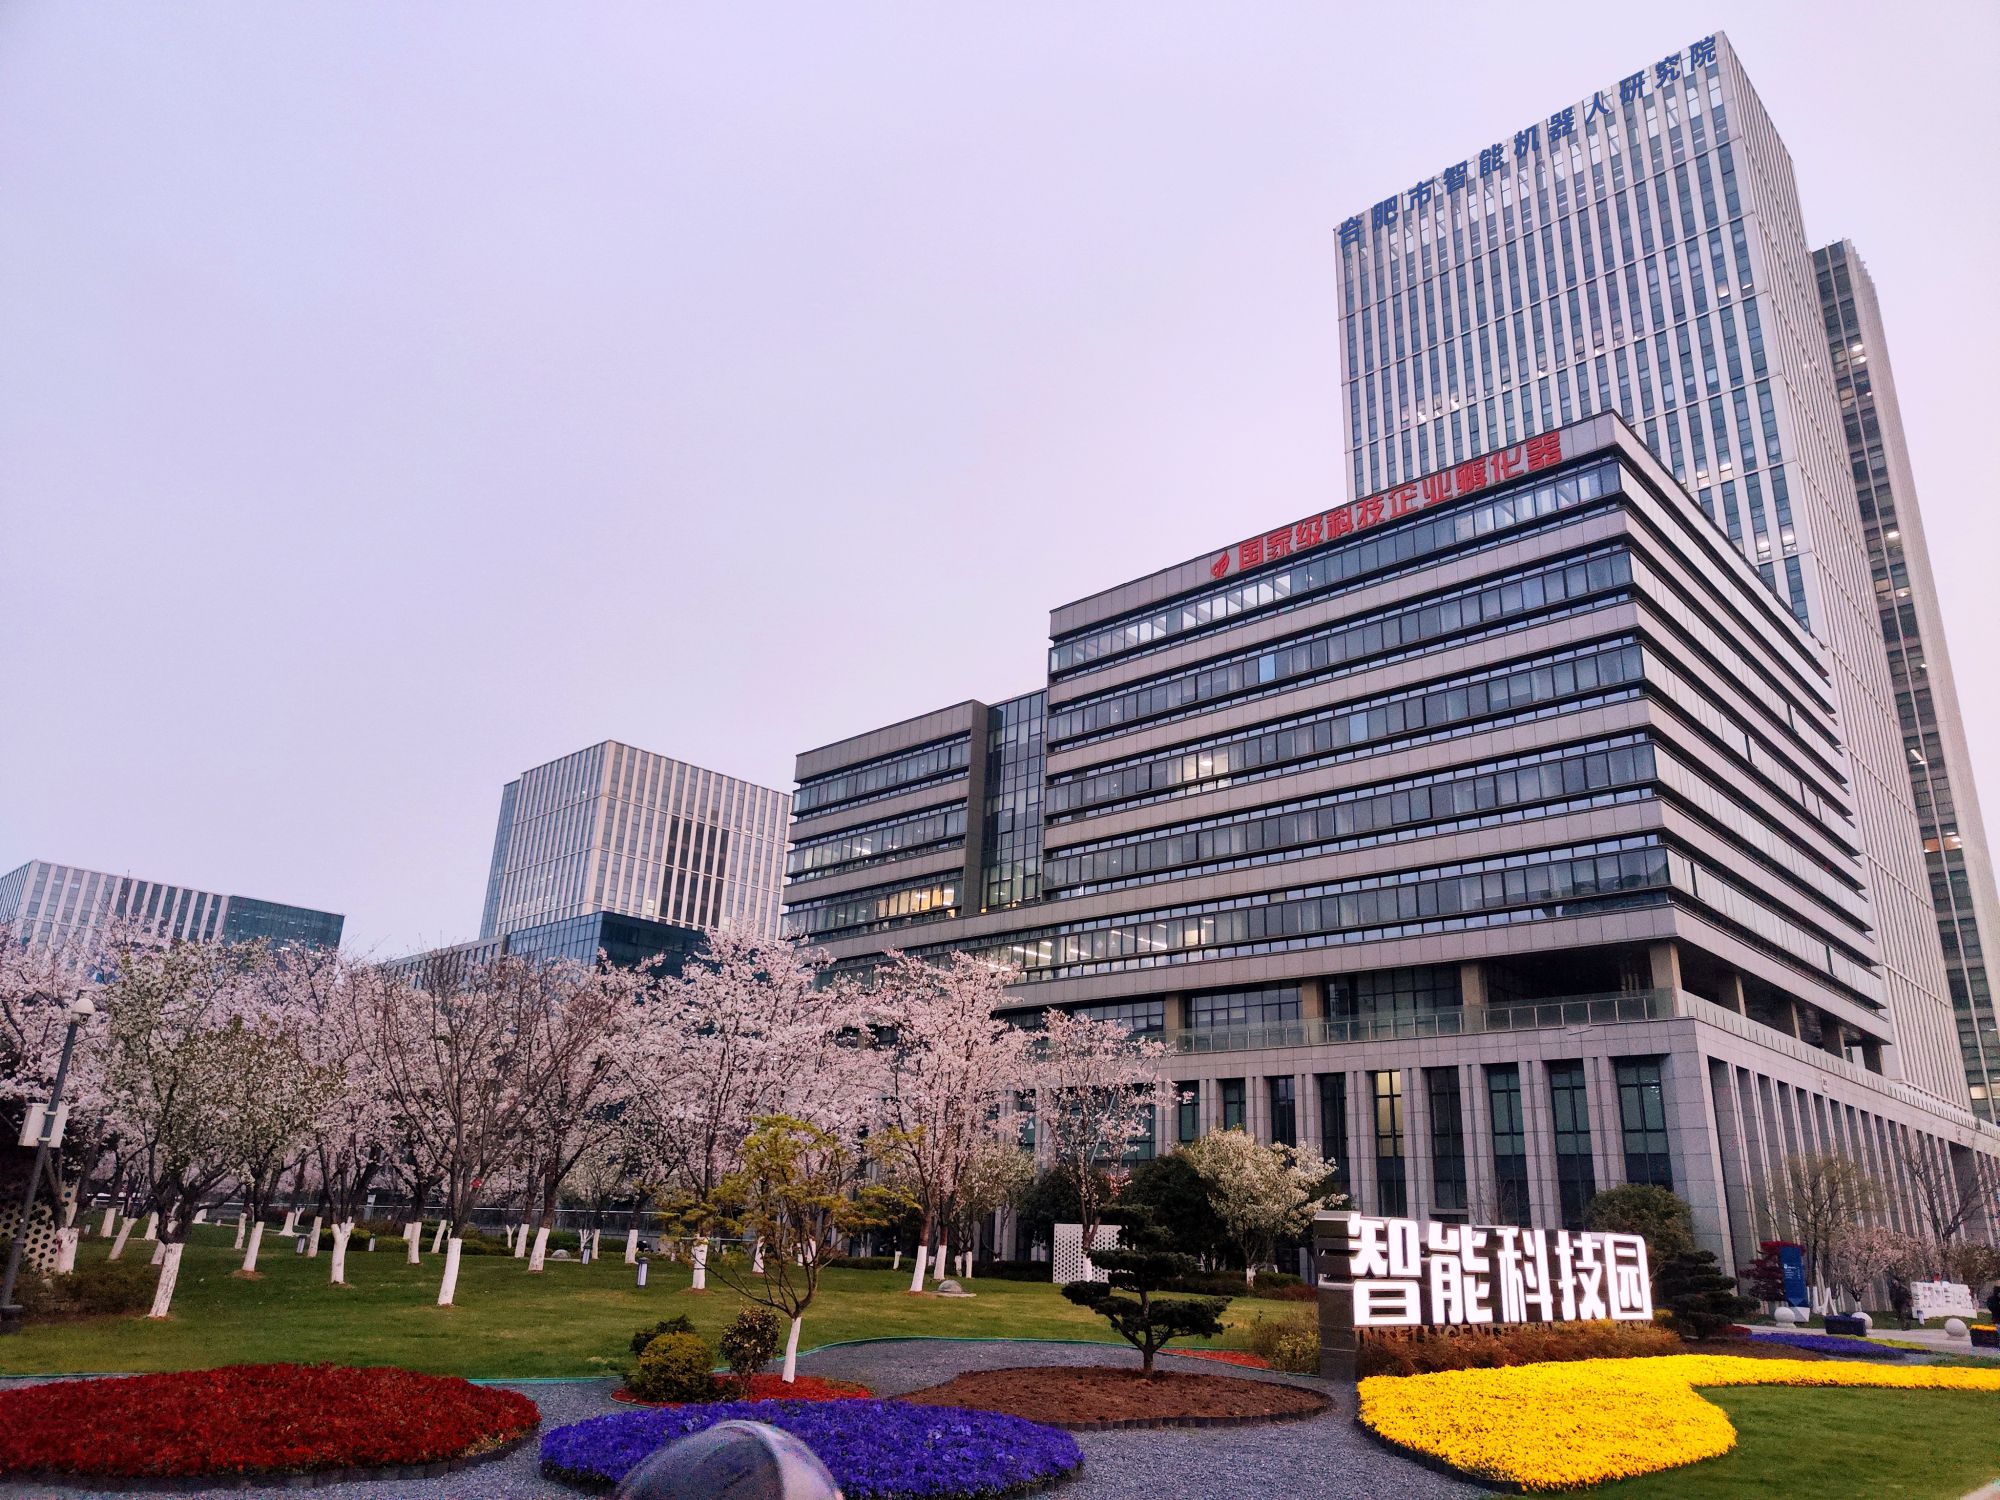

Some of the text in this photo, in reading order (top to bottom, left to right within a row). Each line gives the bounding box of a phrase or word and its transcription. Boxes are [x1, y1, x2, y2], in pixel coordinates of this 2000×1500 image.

[1338, 36, 1716, 248] 合肥市智能机器人研究院
[1239, 432, 1562, 570] 国家级科技企业孵化器
[1348, 1212, 1653, 1326] 智能科技园
